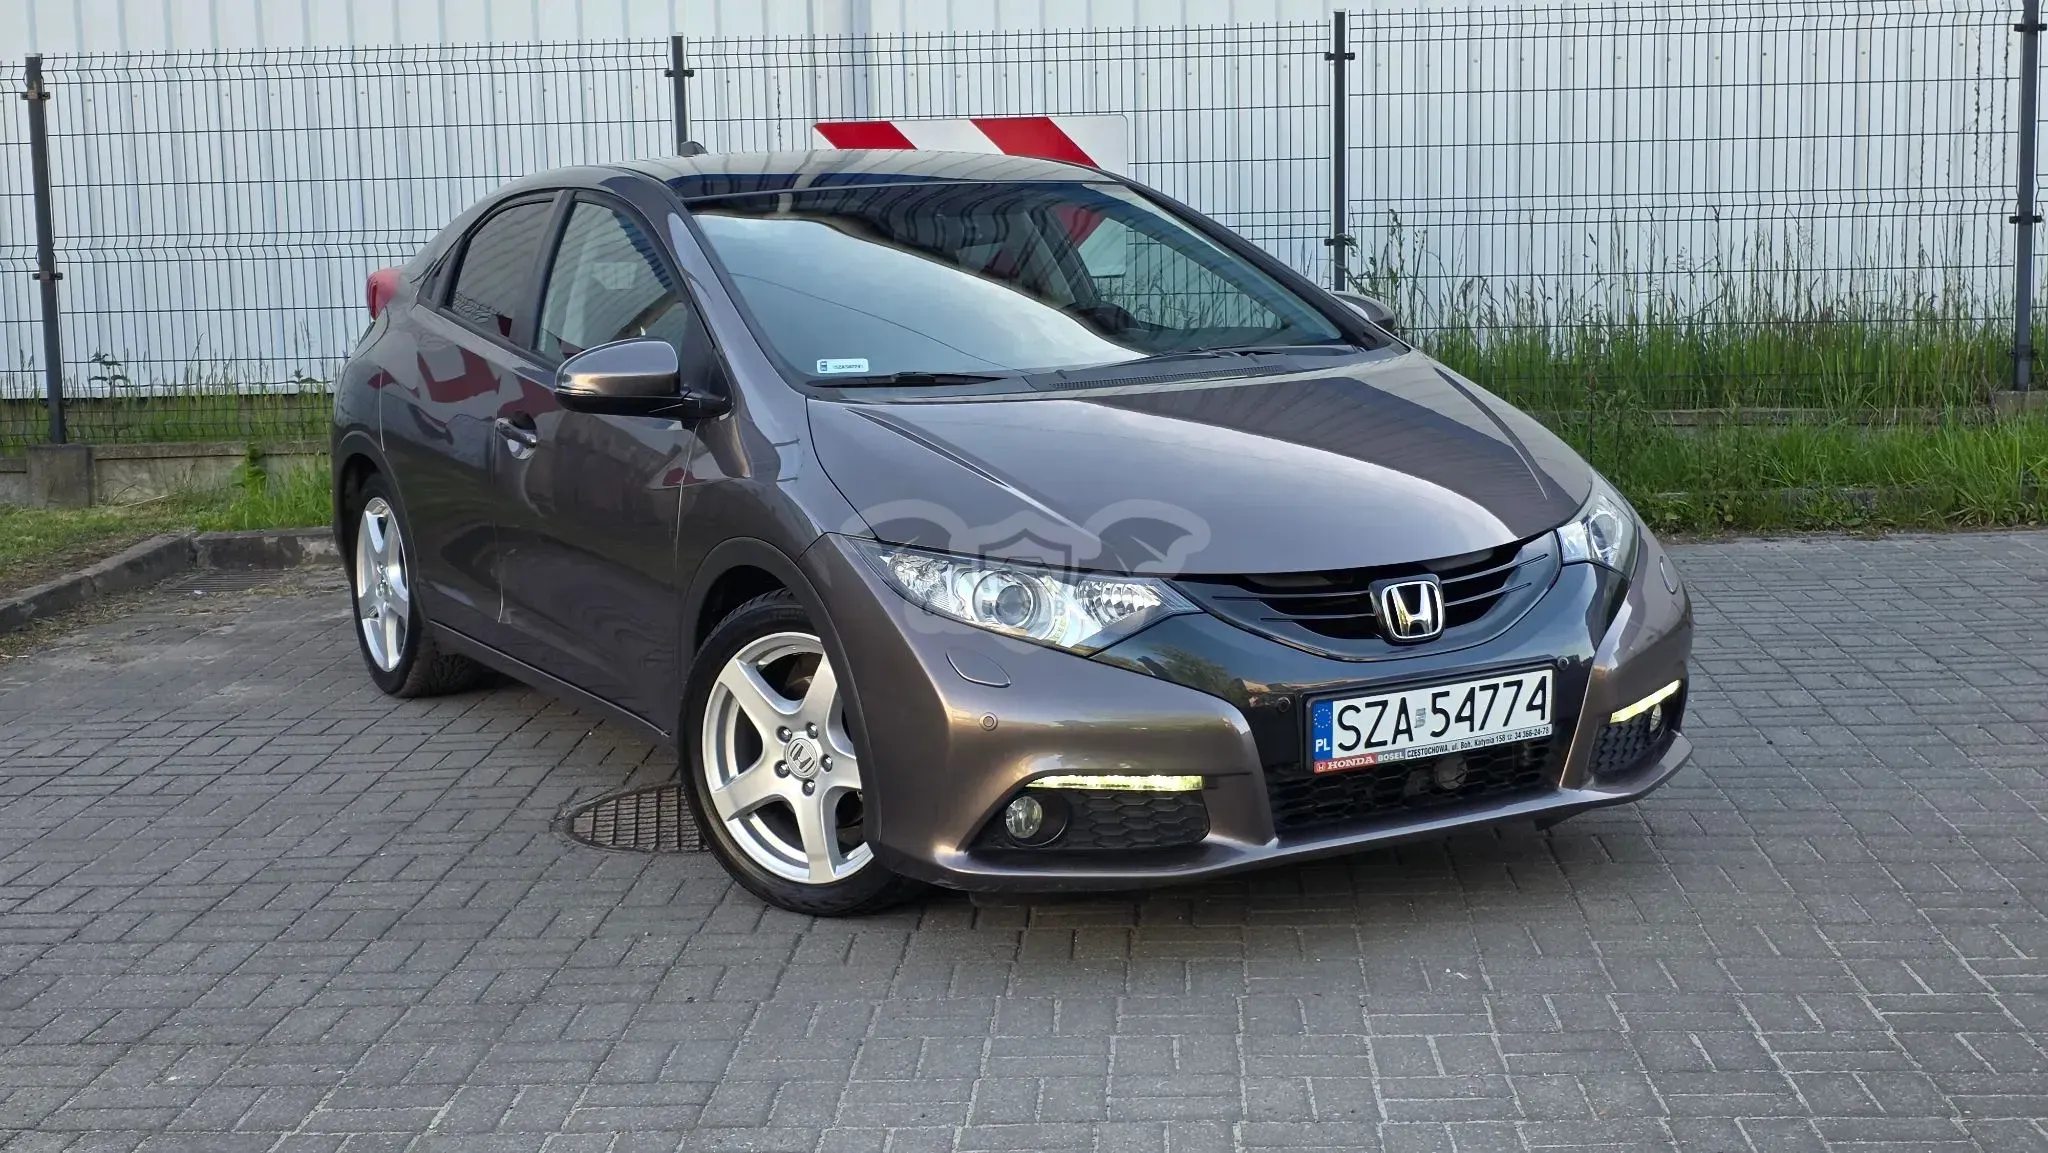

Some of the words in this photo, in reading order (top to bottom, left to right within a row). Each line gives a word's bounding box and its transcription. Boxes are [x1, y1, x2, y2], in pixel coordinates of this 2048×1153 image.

[1337, 697, 1414, 751] SZA
[1430, 675, 1548, 738] 54774
[1315, 738, 1331, 752] PL
[1327, 756, 1375, 770] HONDA
[1378, 751, 1404, 762] BOSEL
